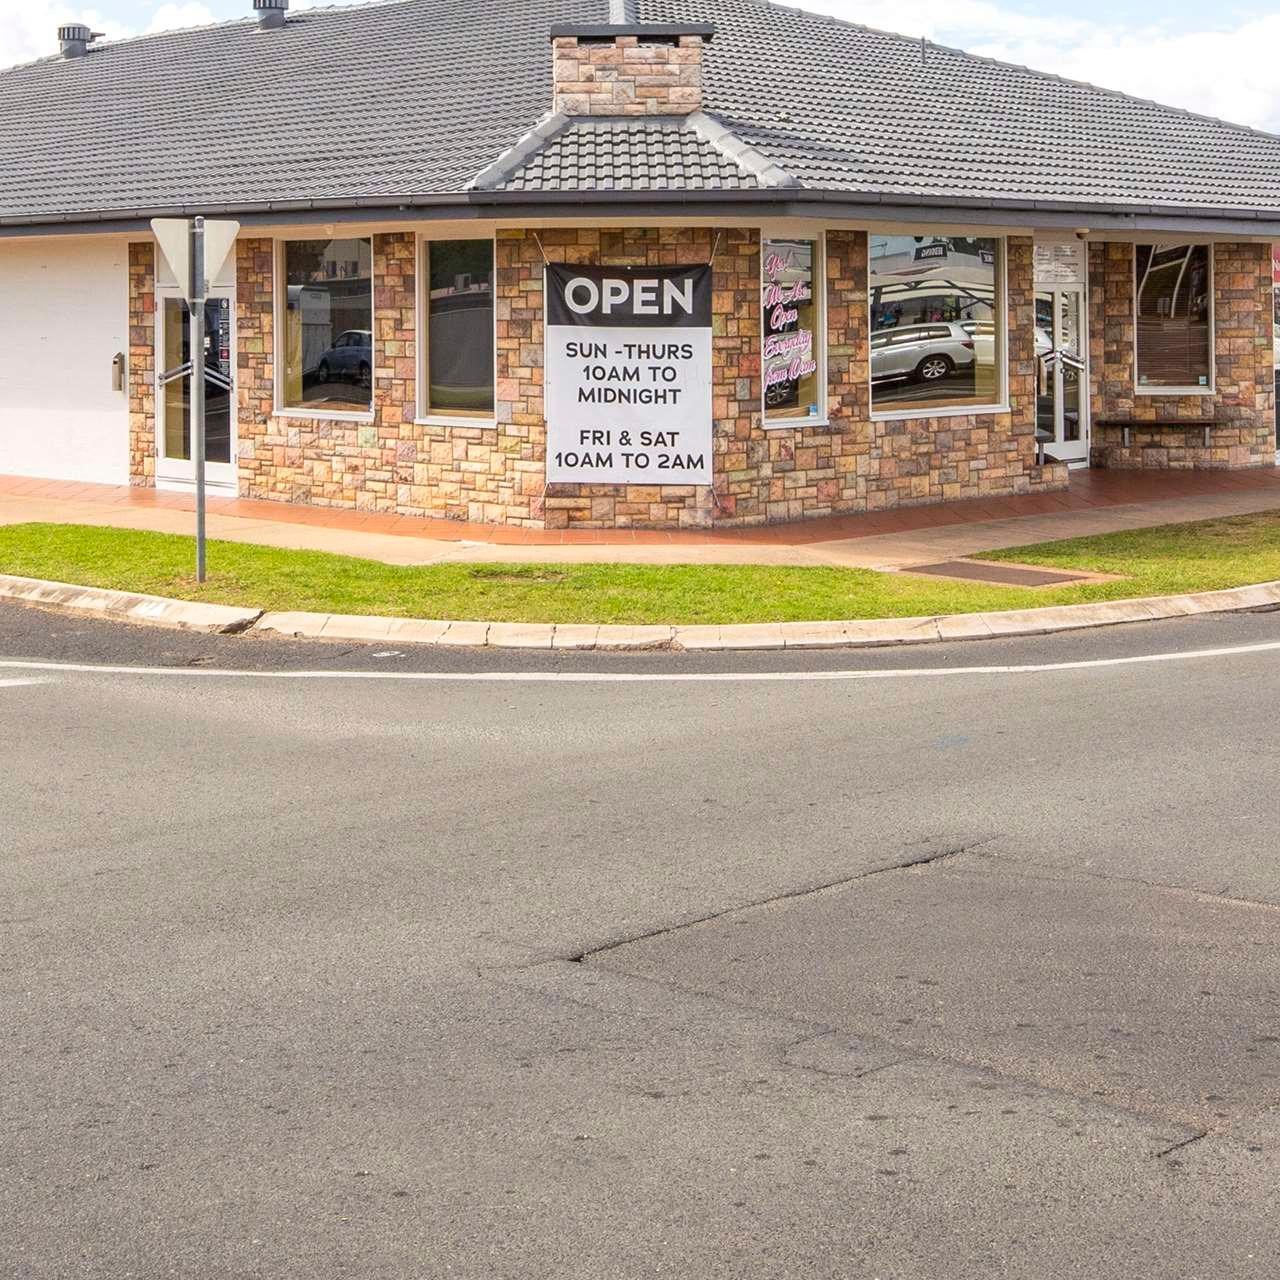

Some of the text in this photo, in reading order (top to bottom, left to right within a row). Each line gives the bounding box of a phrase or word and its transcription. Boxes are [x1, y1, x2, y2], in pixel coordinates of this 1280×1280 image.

[564, 277, 693, 315] OPEN
[770, 303, 799, 331] Open
[566, 342, 607, 359] SUN
[582, 365, 677, 382] 10AM TO
[578, 387, 681, 405] MIDNIGHT
[580, 430, 679, 447] FRI & SAT
[555, 452, 704, 470] 10AM TO 2AM
